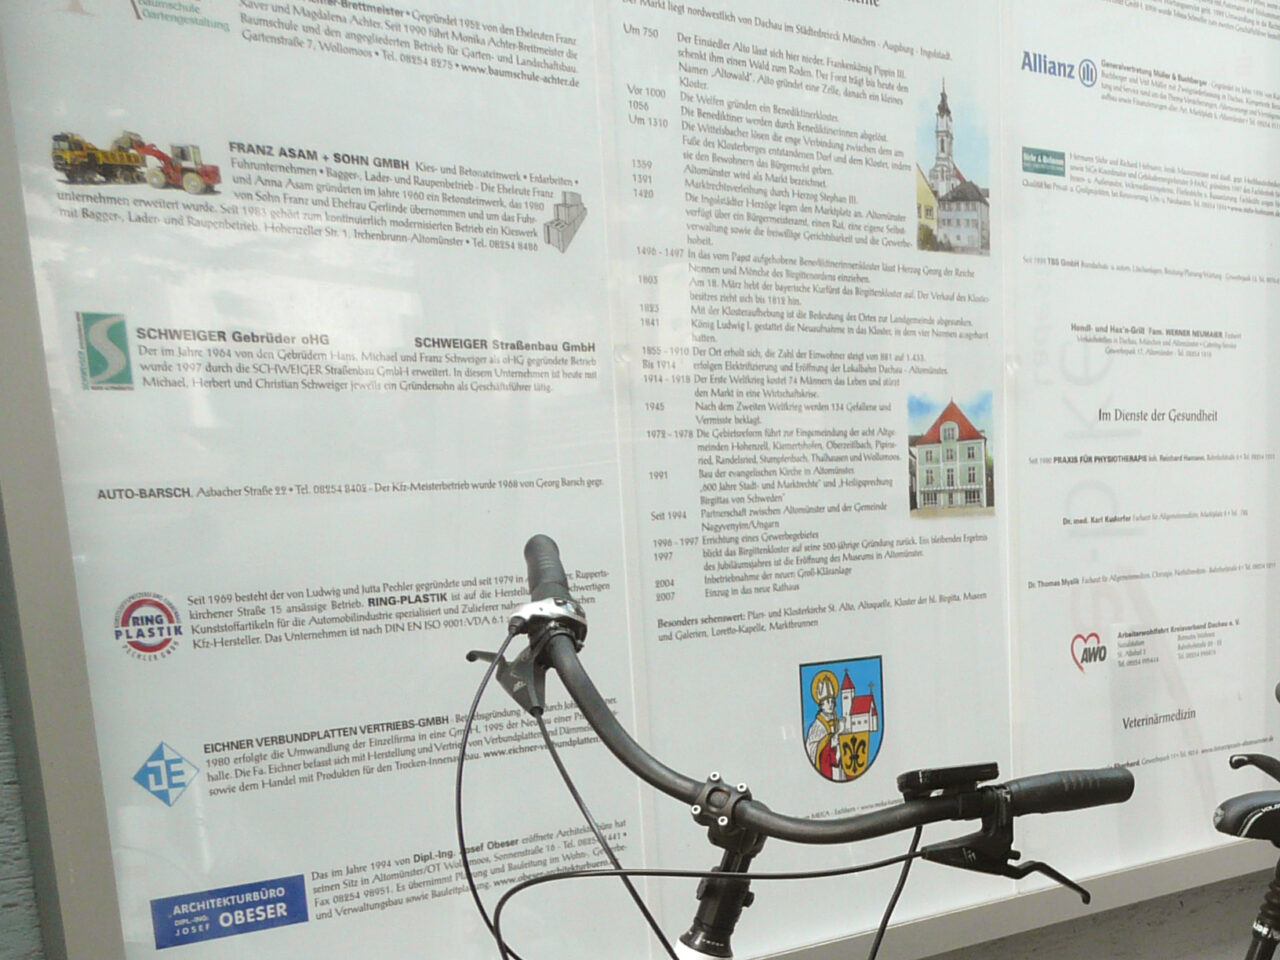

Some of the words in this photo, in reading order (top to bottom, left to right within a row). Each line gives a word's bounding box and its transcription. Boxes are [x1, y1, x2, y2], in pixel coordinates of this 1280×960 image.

[623, 23, 640, 35] Um
[643, 26, 659, 39] 750
[241, 29, 304, 49] Gartenstraße
[318, 40, 372, 57] Wollomoos
[381, 49, 397, 61] Tel.
[460, 61, 580, 88] www.baumschule-achter.de
[1021, 51, 1075, 80] Allianz
[626, 83, 643, 96] Vor
[646, 88, 666, 98] 1000
[628, 114, 645, 126] Um
[648, 117, 669, 128] 1310
[228, 141, 273, 156] FRANZ
[278, 146, 318, 161] ASAM
[332, 152, 369, 166] SOHN
[372, 156, 409, 171] GMBH
[136, 328, 227, 343] SCHWEIGER
[231, 331, 295, 345] Gebrüder
[301, 333, 329, 347] oHG
[414, 337, 488, 351] SCHWEIGER
[492, 339, 558, 351] Straßenbau
[561, 341, 596, 353] GmbH
[1098, 408, 1111, 422] Im
[1114, 408, 1148, 422] Dienste
[1150, 408, 1165, 422] der
[1168, 408, 1218, 423] Gesundheit
[1052, 455, 1078, 464] PRAXIS
[196, 487, 242, 498] Asbacher
[243, 486, 273, 496] Straße
[296, 485, 310, 495] Tel.
[374, 482, 390, 492] Der
[391, 480, 470, 492] Kfz-Meisterbetrieb
[470, 479, 496, 490] wurde
[535, 477, 560, 489] Georg
[650, 511, 665, 521] Seit
[668, 511, 687, 520] 1994
[654, 551, 673, 561] 1997
[186, 595, 206, 605] Seit
[208, 593, 233, 604] 1969
[234, 591, 268, 603] besteht
[269, 590, 284, 601] der
[286, 591, 304, 599] von
[305, 586, 341, 600] Ludwig
[342, 584, 360, 595] und
[361, 583, 381, 595] Jutta
[382, 581, 413, 593] Pechler
[414, 578, 460, 593] gegründete
[461, 577, 477, 588] und
[478, 576, 492, 587] seit
[494, 574, 514, 585] 1979
[515, 573, 525, 584] in
[655, 579, 675, 588] 2004
[704, 586, 730, 599] Einzug
[730, 585, 739, 595] in
[740, 583, 752, 594] das
[753, 585, 770, 593] neue
[772, 580, 800, 592] Rathaus
[188, 607, 233, 620] kirchener
[236, 606, 266, 617] Straße
[271, 605, 282, 615] 15
[286, 602, 327, 616] ansässige
[330, 598, 364, 612] Betrieb.
[367, 592, 448, 609] RING-PLASTIK
[655, 592, 676, 602] 2007
[132, 614, 164, 627] RING
[190, 619, 274, 635] Kunststoffartikeln
[276, 618, 289, 629] für
[291, 616, 306, 628] die
[308, 610, 393, 626] Automobilindustrie
[394, 606, 442, 621] spezialisiert
[442, 604, 460, 616] und
[461, 601, 497, 614] Zulieferer
[657, 615, 698, 628] Besonders
[114, 624, 184, 640] PLASTIK
[192, 634, 262, 649] Kfz-Hersteller.
[264, 633, 282, 644] Das
[284, 628, 348, 643] Unternehmen
[349, 626, 360, 637] ist
[361, 624, 383, 636] nach
[384, 622, 405, 634] DIN
[406, 621, 422, 632] EN
[424, 620, 441, 631] ISO
[1080, 645, 1107, 664] AWO
[1122, 708, 1196, 729] Veterinärmedizin
[203, 739, 254, 753] EICHNER
[255, 726, 358, 748] VERBUNDPLATTEN
[359, 715, 449, 736] VERTRIEBS-GMBH
[206, 754, 230, 767] 1980
[232, 750, 268, 766] erfolgte
[270, 748, 284, 760] die
[286, 741, 350, 760] Umwandlung
[352, 739, 366, 750] der
[368, 733, 416, 749] Einzelfirma
[418, 731, 427, 742] in
[428, 728, 448, 741] eine
[310, 868, 328, 881] Das
[330, 866, 343, 878] im
[345, 863, 367, 877] Jahre
[370, 859, 392, 872] 1994
[394, 857, 411, 868] von
[487, 838, 519, 850] Obeser
[172, 886, 285, 915] ARCHITEKTURBÜRO
[219, 903, 287, 927] OBESER
[175, 923, 210, 937] JOSEF
